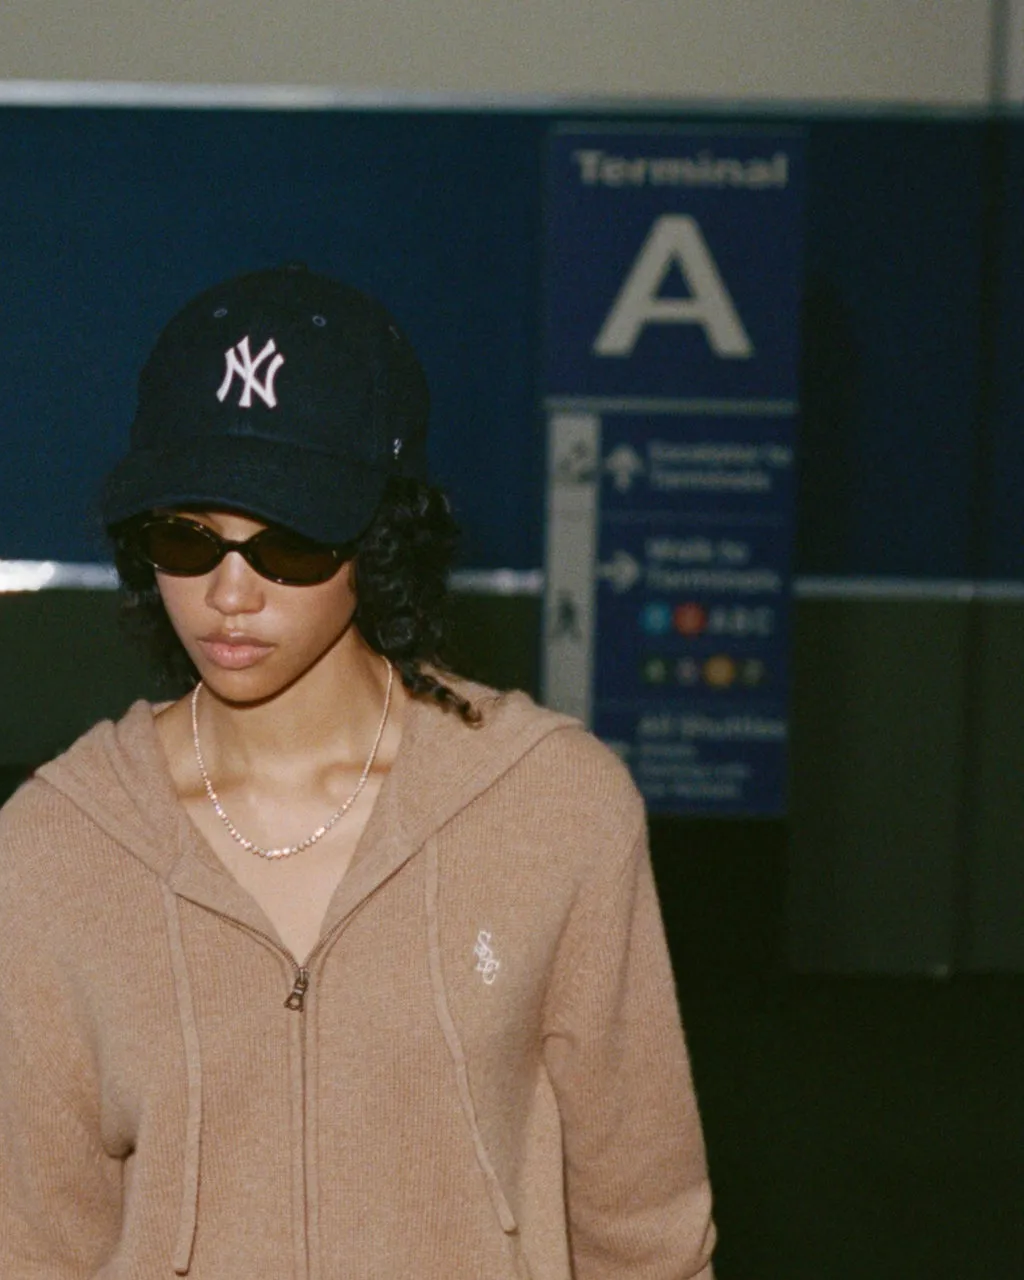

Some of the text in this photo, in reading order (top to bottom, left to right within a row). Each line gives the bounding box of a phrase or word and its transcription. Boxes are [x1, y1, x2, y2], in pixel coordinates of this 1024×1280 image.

[576, 149, 789, 188] Terminal
[592, 213, 754, 357] A
[215, 334, 285, 409] NY
